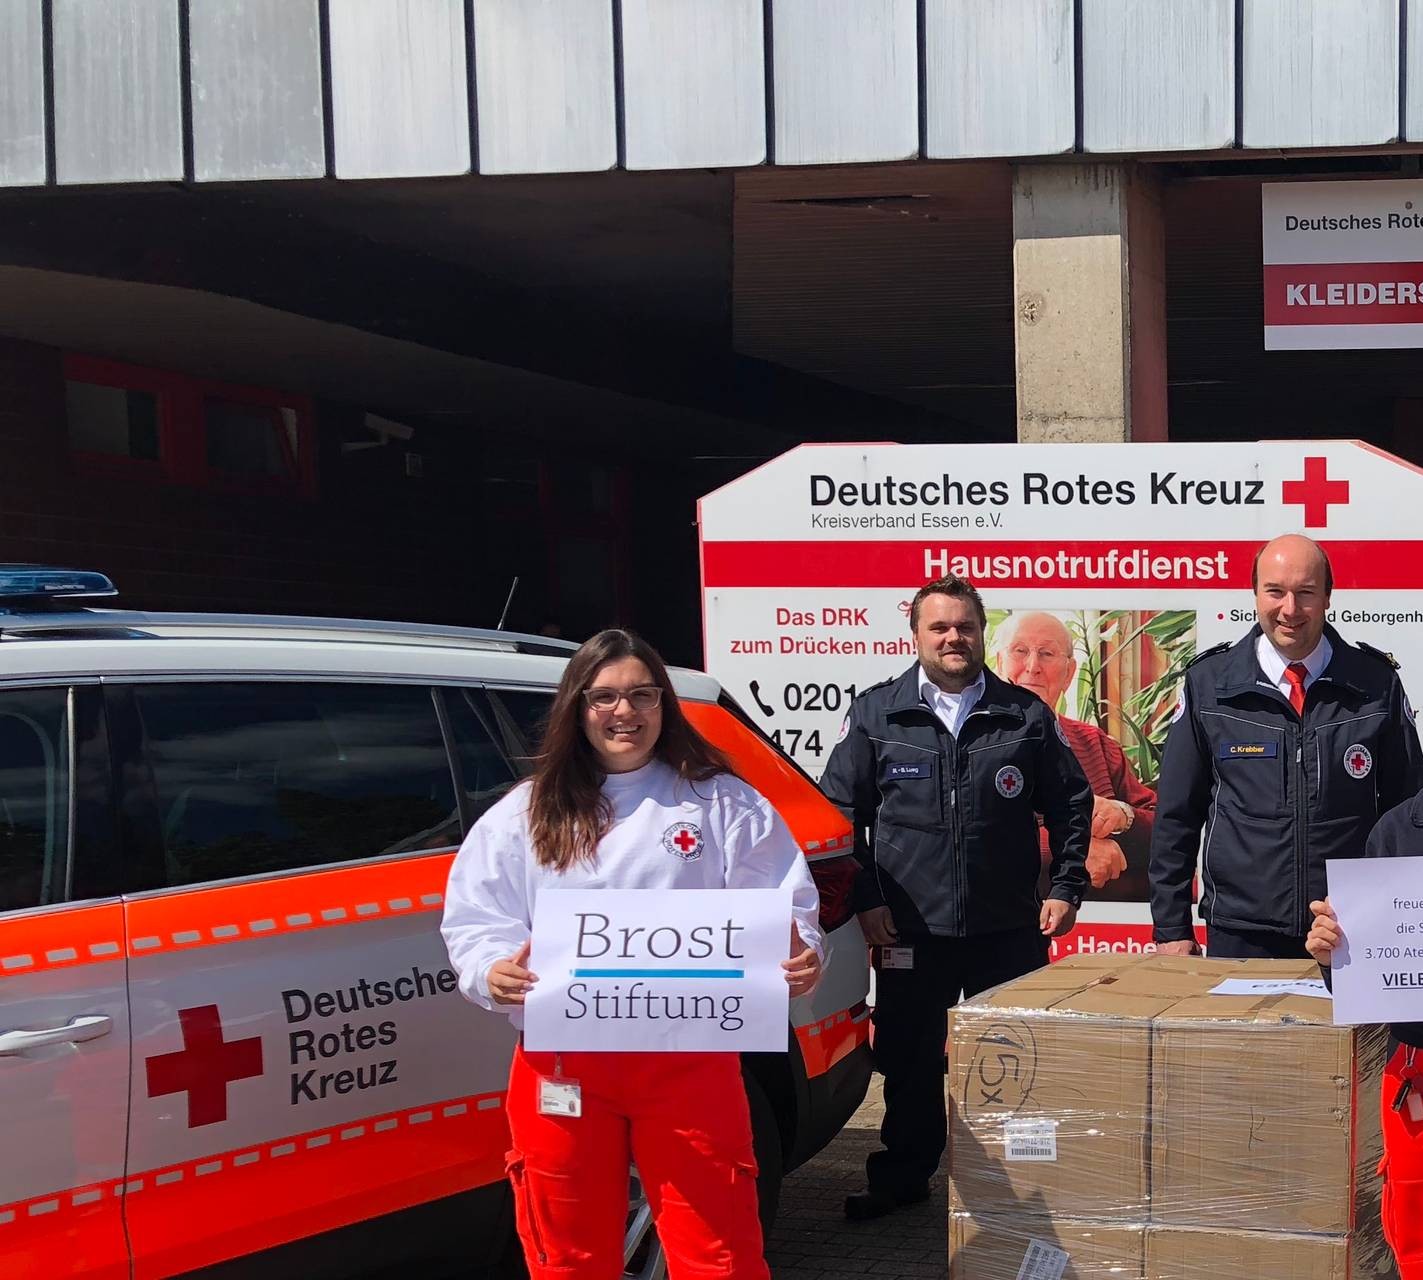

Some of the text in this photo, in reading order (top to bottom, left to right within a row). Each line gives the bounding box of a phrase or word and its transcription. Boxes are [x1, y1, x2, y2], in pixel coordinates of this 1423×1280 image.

[1285, 214, 1382, 231] Deutsches
[810, 472, 1265, 506] Deutsches Rotes Kreuz
[811, 513, 1003, 529] Kreisverband Essen e.V.
[924, 549, 1229, 580] Hausnotrufdienst
[776, 608, 869, 626] Das DRK
[730, 637, 916, 655] zum Drücken nah!
[784, 683, 856, 711] 0201
[574, 913, 744, 959] Brost
[1396, 922, 1416, 934] die
[1077, 936, 1157, 957] Hache
[1365, 947, 1400, 959] 3.700
[281, 966, 457, 1024] Deutsche
[565, 982, 744, 1031] Stiftung
[289, 1020, 397, 1065] Rotes
[290, 1059, 398, 1105] Kreuz
